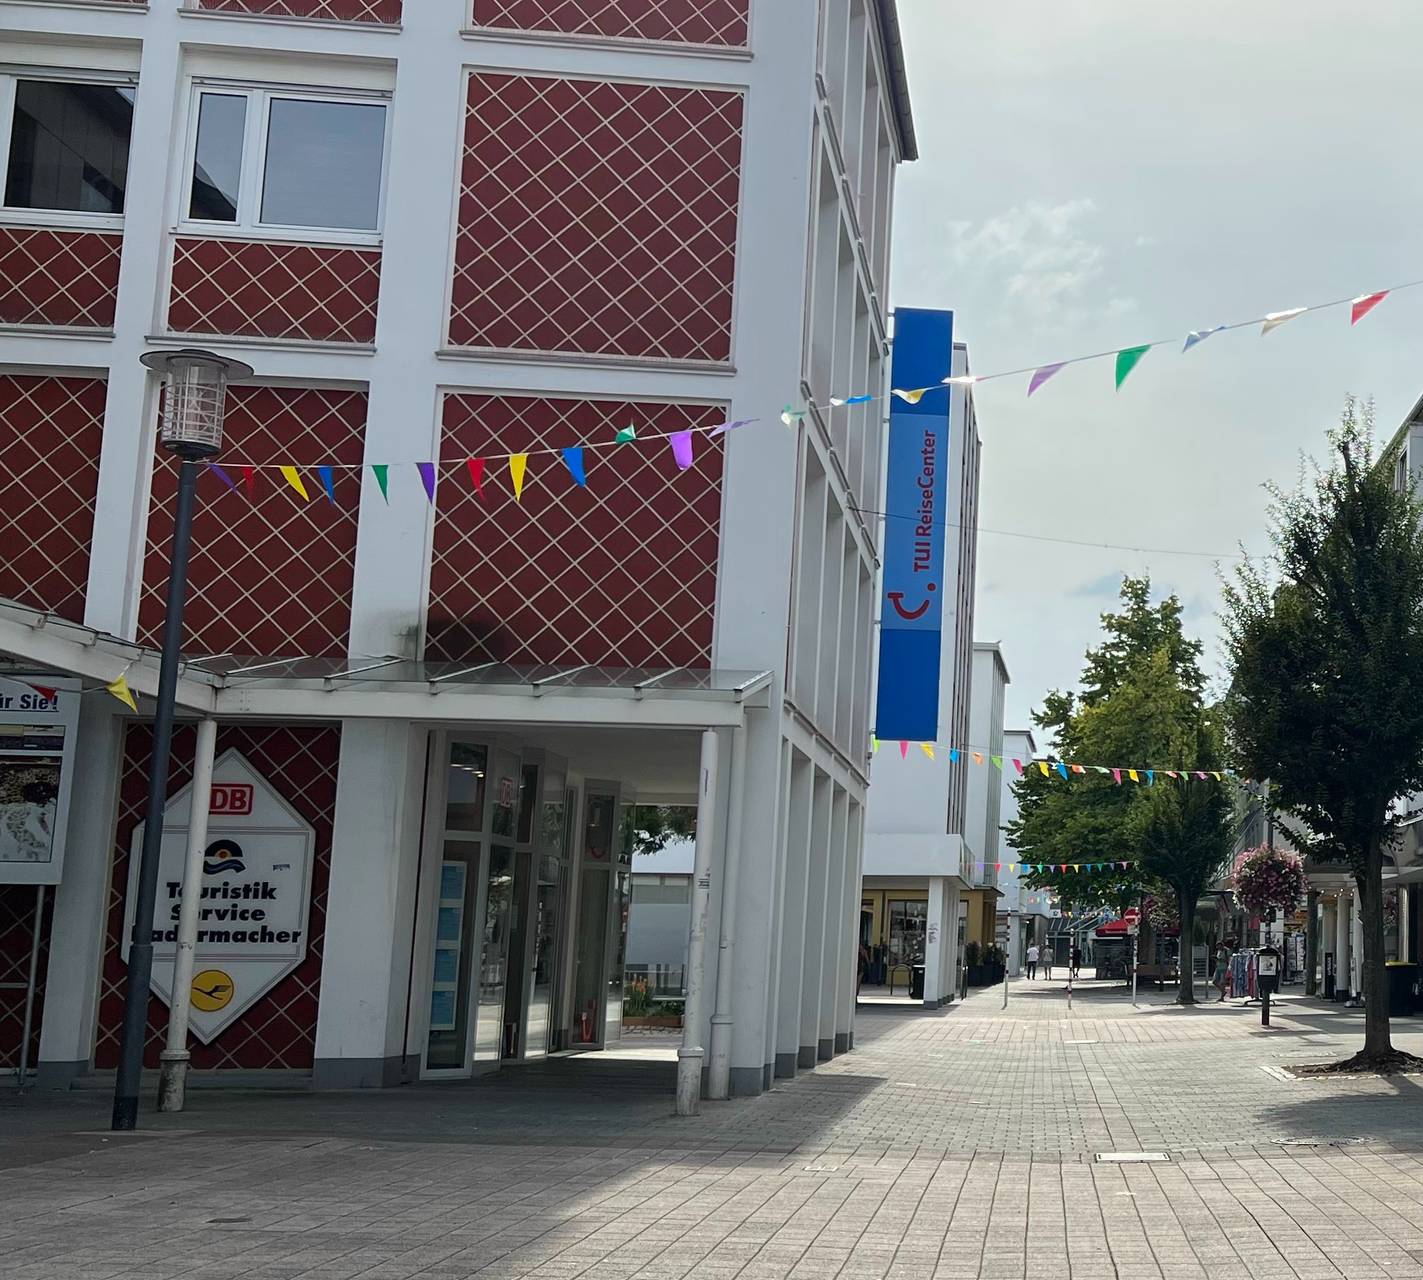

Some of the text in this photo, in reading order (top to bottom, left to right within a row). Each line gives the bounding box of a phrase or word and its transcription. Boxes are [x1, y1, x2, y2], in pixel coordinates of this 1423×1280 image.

[914, 430, 936, 573] TUI ReiseCenter
[210, 788, 247, 810] DB
[167, 882, 277, 899] Turistik
[170, 903, 266, 921] Srvice
[131, 925, 301, 943] adrmacher
